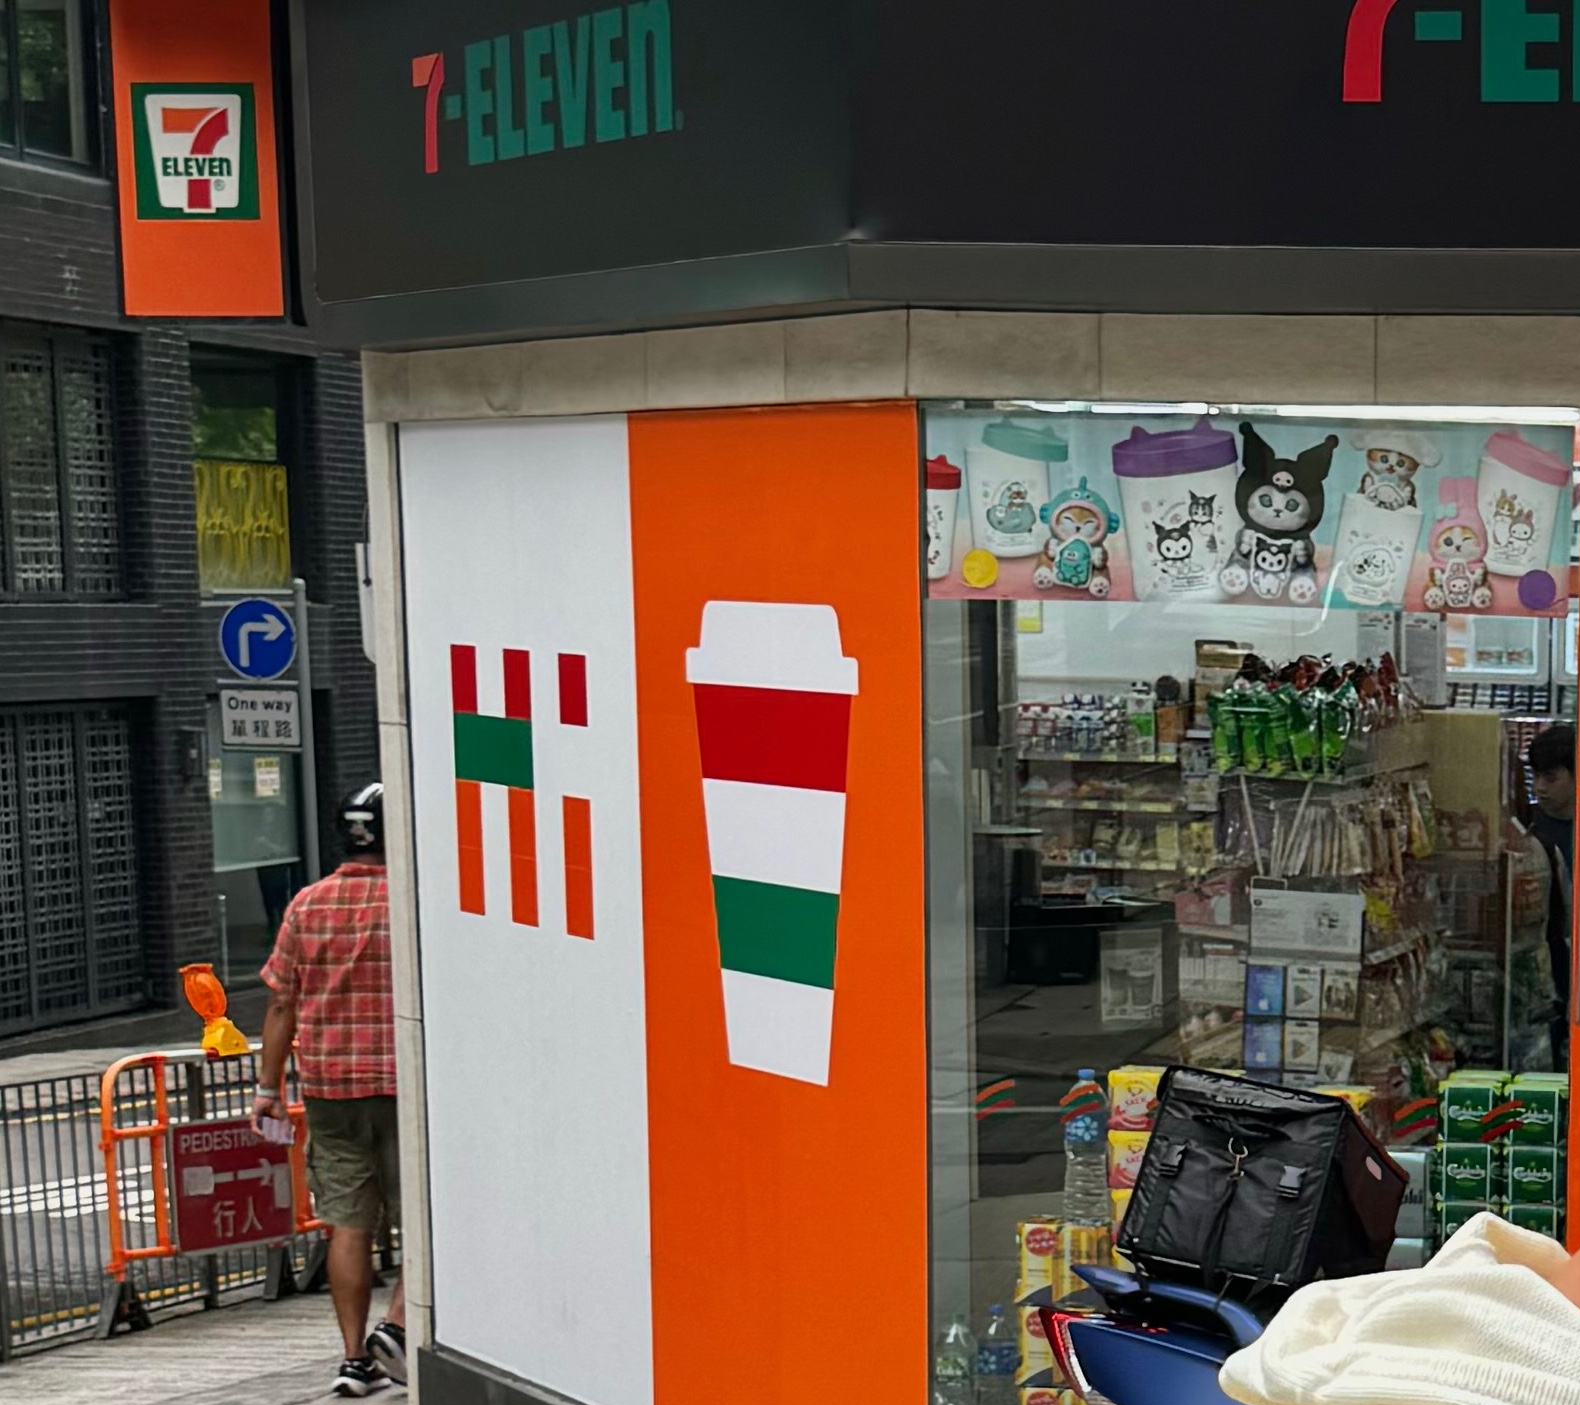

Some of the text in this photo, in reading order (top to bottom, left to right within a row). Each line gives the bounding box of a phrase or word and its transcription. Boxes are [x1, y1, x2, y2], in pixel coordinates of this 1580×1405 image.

[228, 696, 292, 713] One way
[213, 1195, 263, 1239] 行人
